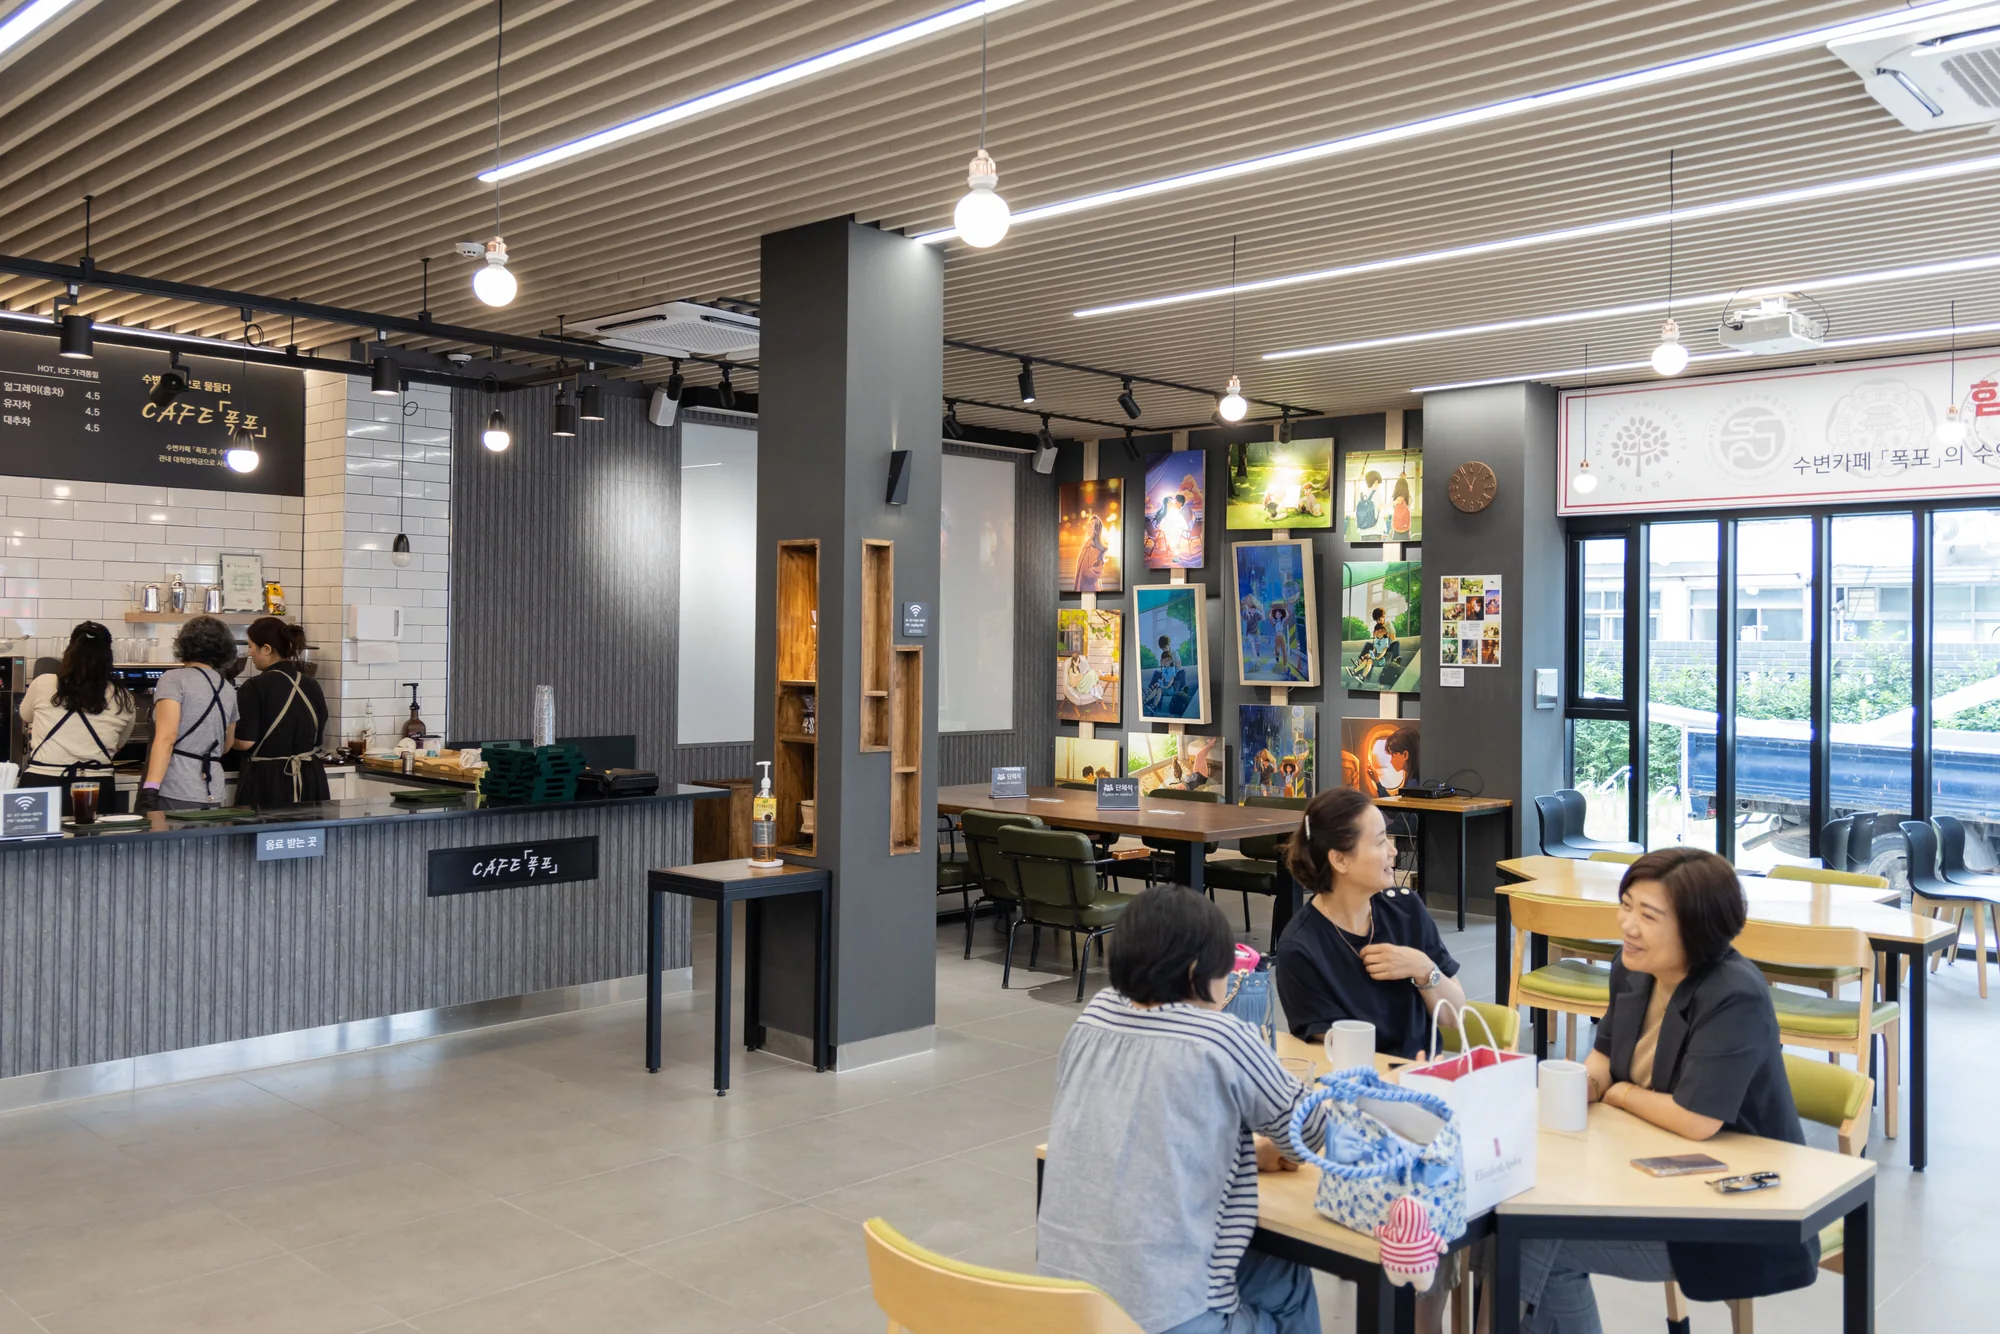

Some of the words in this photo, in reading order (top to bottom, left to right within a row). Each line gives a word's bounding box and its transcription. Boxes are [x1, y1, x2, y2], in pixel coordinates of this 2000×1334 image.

[58, 367, 70, 375] ICE
[72, 368, 99, 379] 가격동일
[3, 381, 65, 398] 얼그레이(홍차)
[85, 391, 101, 401] 4.5
[204, 381, 231, 393] 물들다
[3, 398, 32, 411] 유자차
[84, 407, 100, 417] 4.5
[142, 402, 214, 425] CAFE
[3, 415, 32, 427] 대추차
[84, 423, 100, 433] 4.5
[1793, 451, 1871, 476] 수변카페
[1115, 784, 1133, 792] 단체석
[265, 839, 284, 851] 음료
[287, 837, 305, 849] 받는
[307, 836, 318, 847] 곳
[472, 858, 521, 878] CAFE
